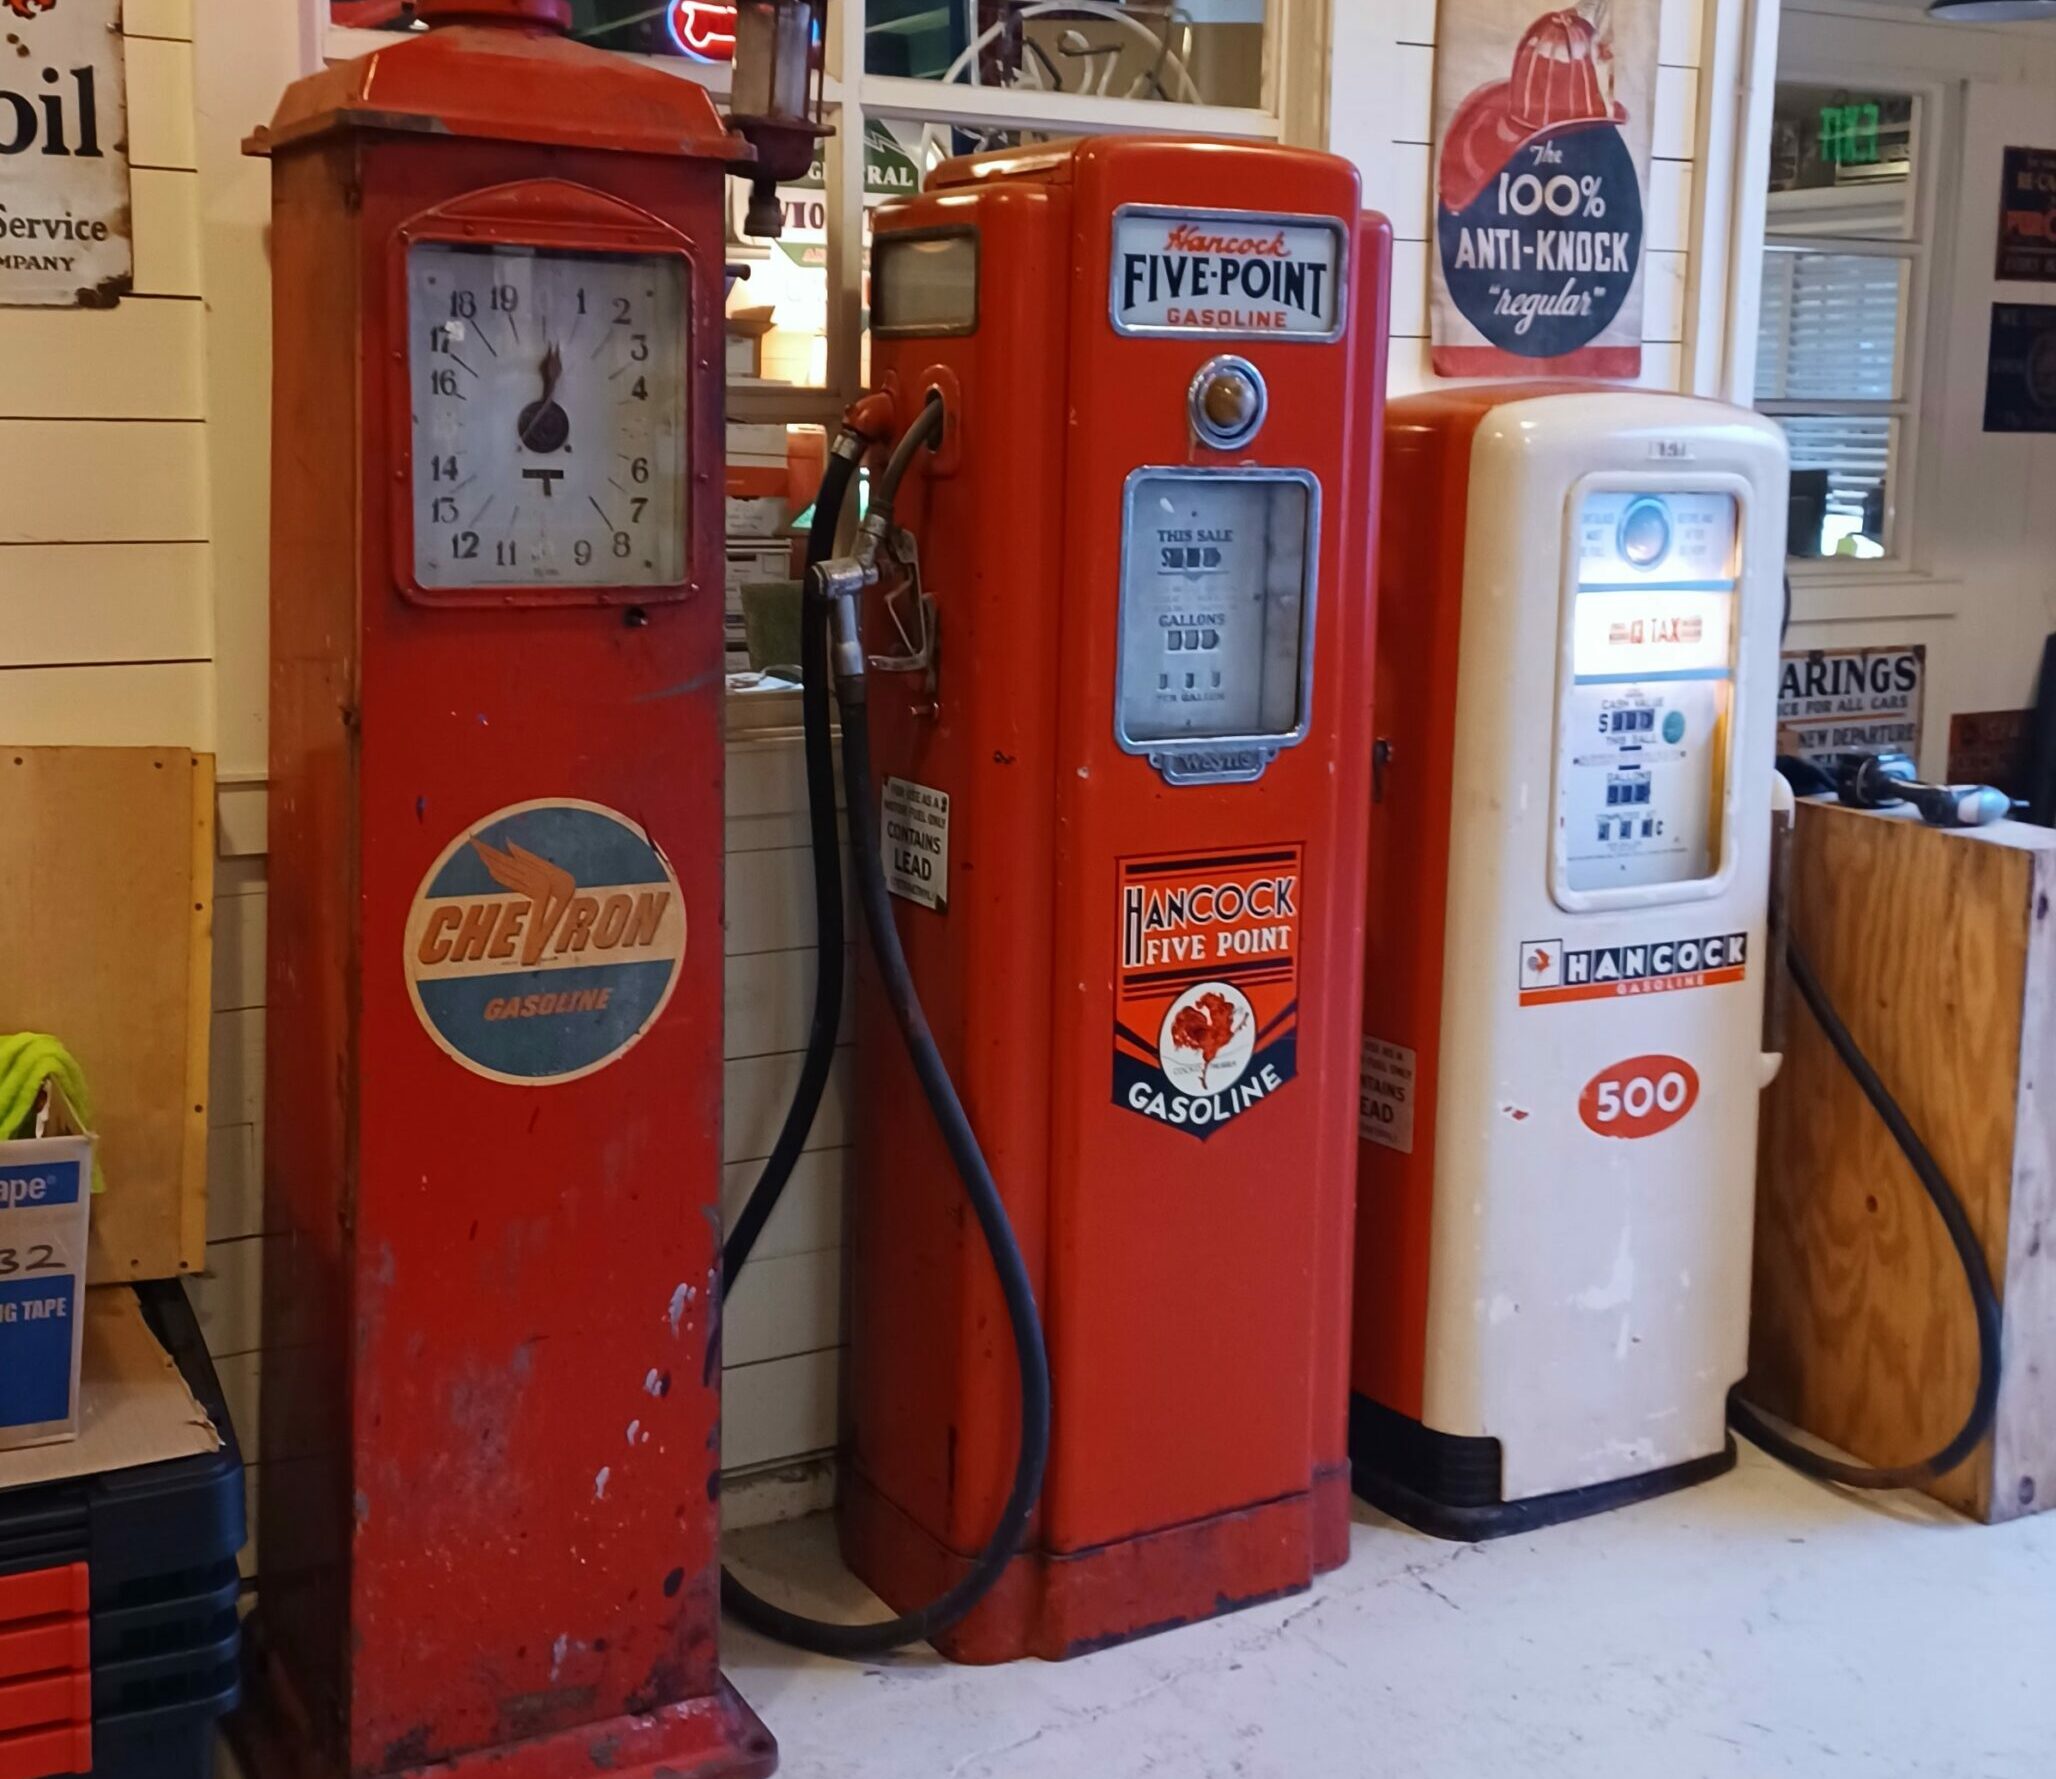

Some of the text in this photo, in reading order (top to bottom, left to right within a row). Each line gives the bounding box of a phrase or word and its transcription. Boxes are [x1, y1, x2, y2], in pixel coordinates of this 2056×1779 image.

[1529, 140, 1563, 165] The
[1498, 172, 1606, 218] 100%
[1163, 223, 1291, 257] Hancock
[1454, 227, 1630, 273] ANTI-KNOCK
[449, 290, 477, 319] 18
[490, 285, 518, 312] 19
[576, 288, 587, 315] 1
[612, 298, 632, 326] 2
[1167, 307, 1288, 328] GASOLINE
[430, 325, 451, 353] 17
[631, 334, 649, 361] 3
[431, 369, 458, 396] 16
[631, 376, 649, 400] 4
[431, 455, 458, 481] 14
[631, 457, 649, 483] 6
[631, 497, 648, 523] 7
[452, 531, 480, 559] 12
[613, 532, 631, 558] 8
[1157, 529, 1234, 542] THIS SALE
[496, 541, 516, 567] 11
[574, 540, 592, 566] 9
[1158, 613, 1226, 628] GALLONS
[1837, 698, 1864, 711] ALL
[1871, 695, 1908, 709] CARS
[887, 820, 941, 855] CONTAINS
[894, 848, 932, 881] LEAD
[417, 890, 671, 967] CHEVRON
[1122, 876, 1297, 968] HANCOCK
[1146, 925, 1292, 966] FIVE POINT
[1567, 936, 1746, 982] HANCOCK
[1616, 974, 1705, 995] GASOLINE
[483, 987, 612, 1021] GASOLINE
[1128, 1063, 1283, 1125] GASOLINE
[1596, 1070, 1688, 1122] 500
[21, 1297, 67, 1321] TAPE
